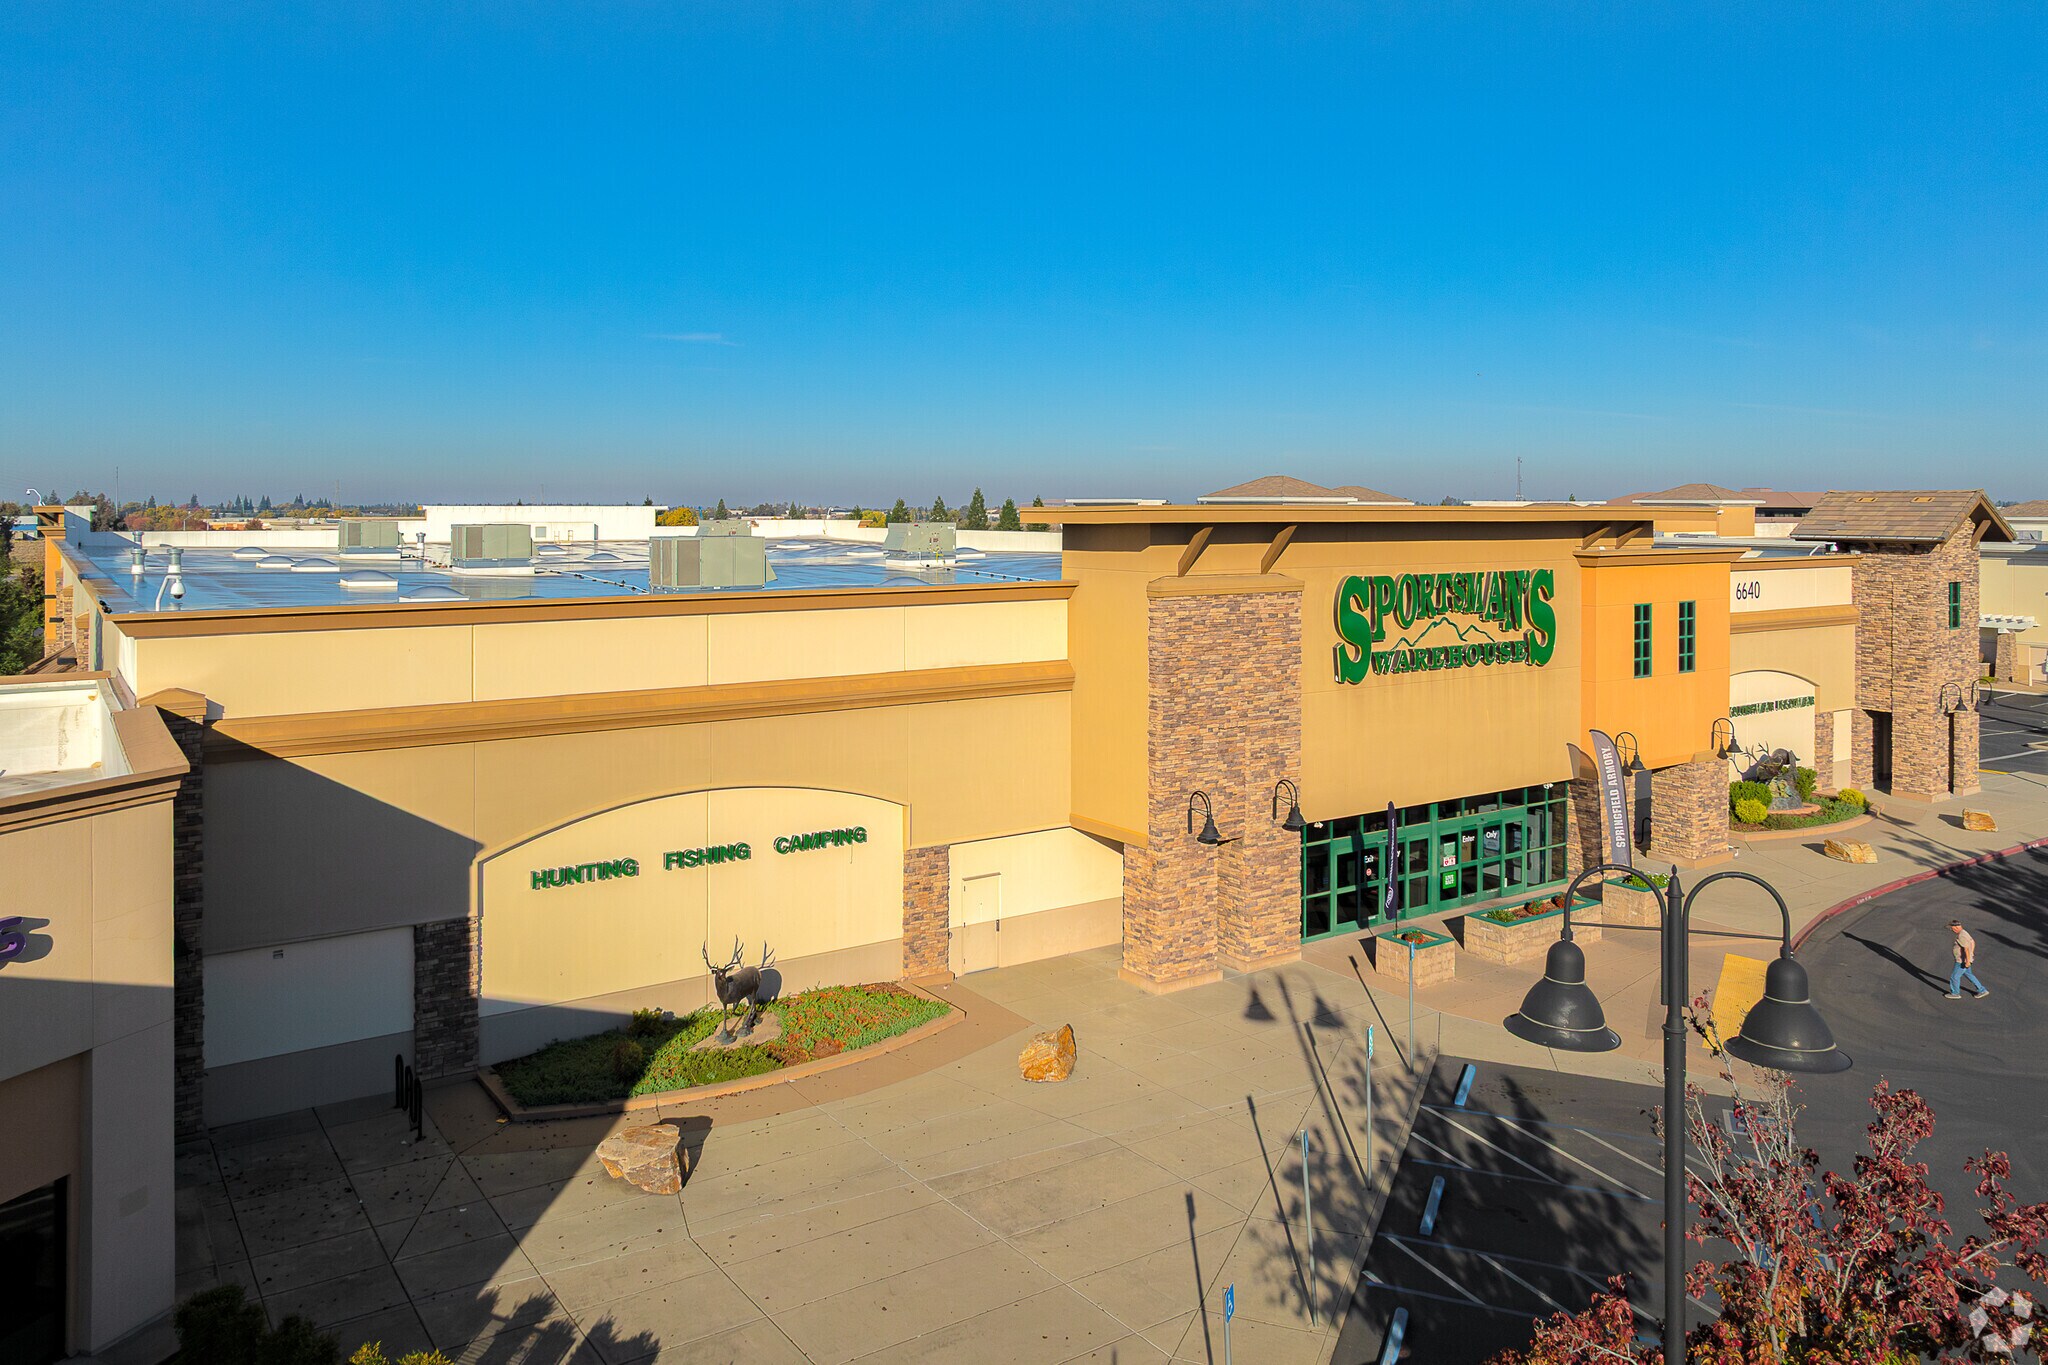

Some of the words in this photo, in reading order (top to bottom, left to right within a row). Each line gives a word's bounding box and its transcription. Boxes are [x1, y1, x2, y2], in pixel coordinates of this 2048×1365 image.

[1736, 581, 1761, 600] 6640
[1371, 640, 1528, 676] WAREHOUSE
[1609, 788, 1626, 848] SPRINGFIELD
[531, 857, 640, 890] HUNTING
[663, 841, 751, 871] FISHING
[774, 826, 867, 855] CAMPING
